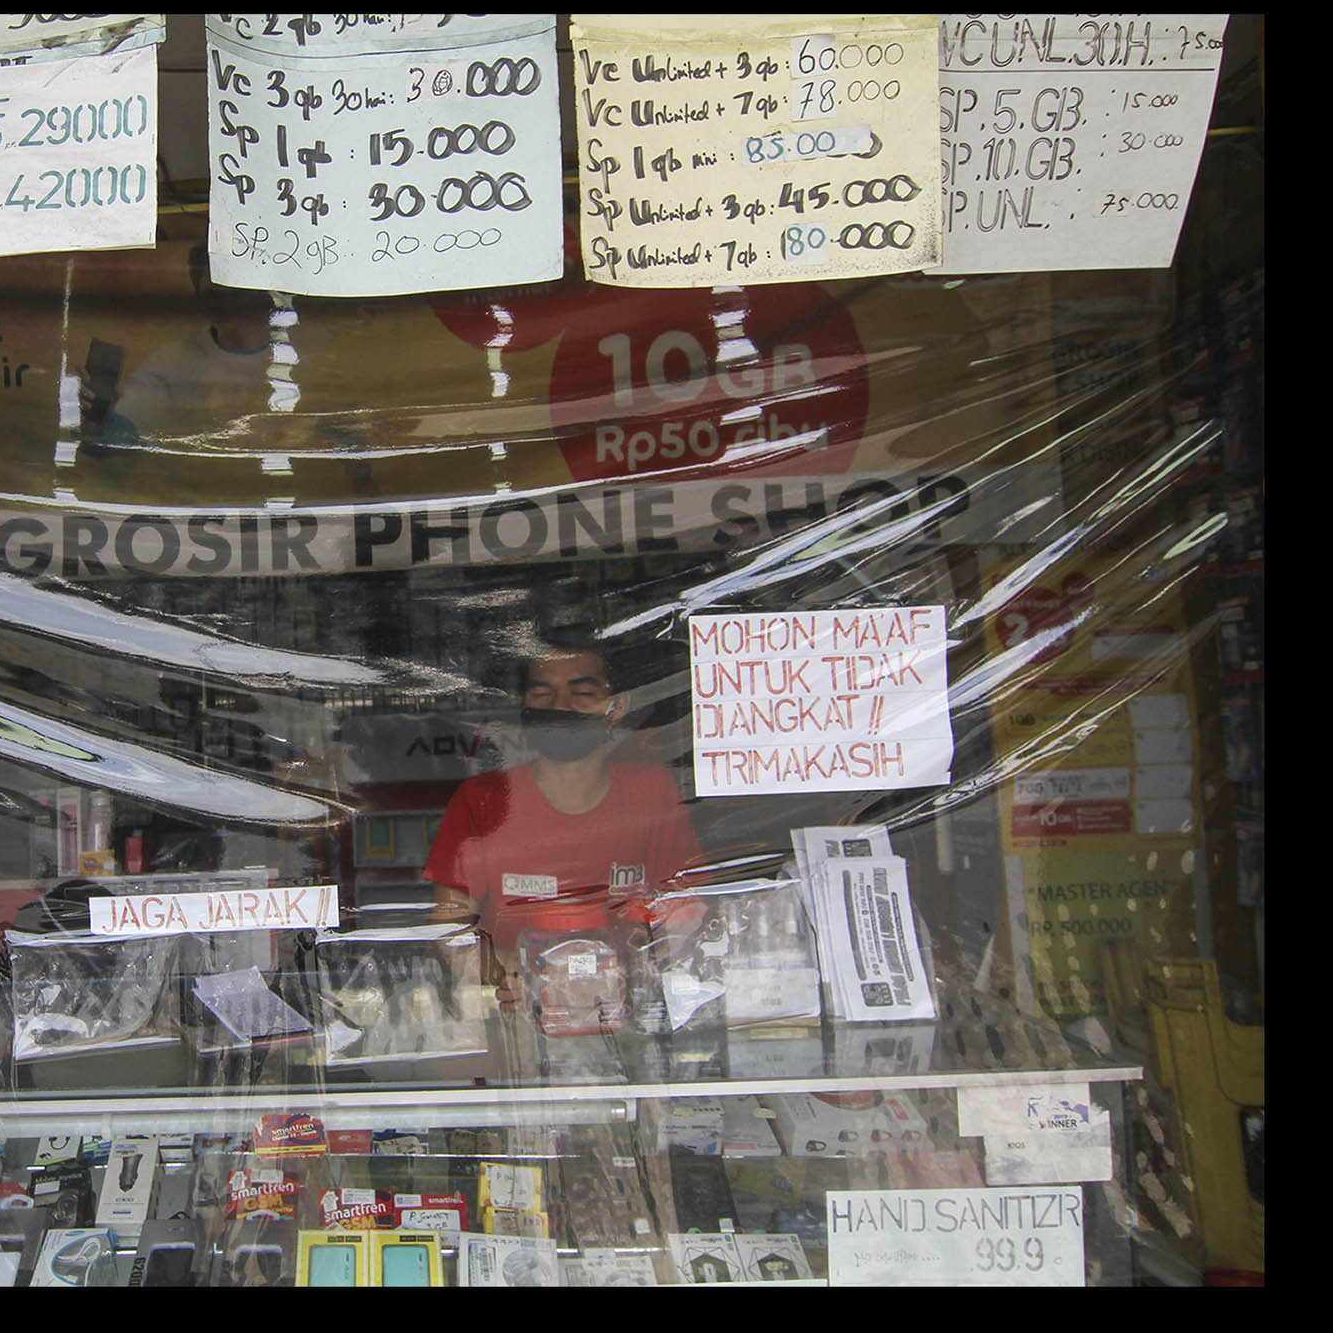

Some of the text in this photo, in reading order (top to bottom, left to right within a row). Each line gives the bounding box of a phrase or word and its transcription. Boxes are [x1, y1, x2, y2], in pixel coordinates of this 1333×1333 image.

[354, 487, 678, 565] PHONE
[709, 474, 970, 545] SHOP
[692, 616, 816, 657] MOHON
[694, 651, 923, 698] UNTUK TIDAK
[702, 742, 903, 787] TRIMAKASIH
[103, 889, 308, 932] JAGA JARAK
[231, 1181, 294, 1200] smartfren
[325, 1201, 386, 1222] smartfren
